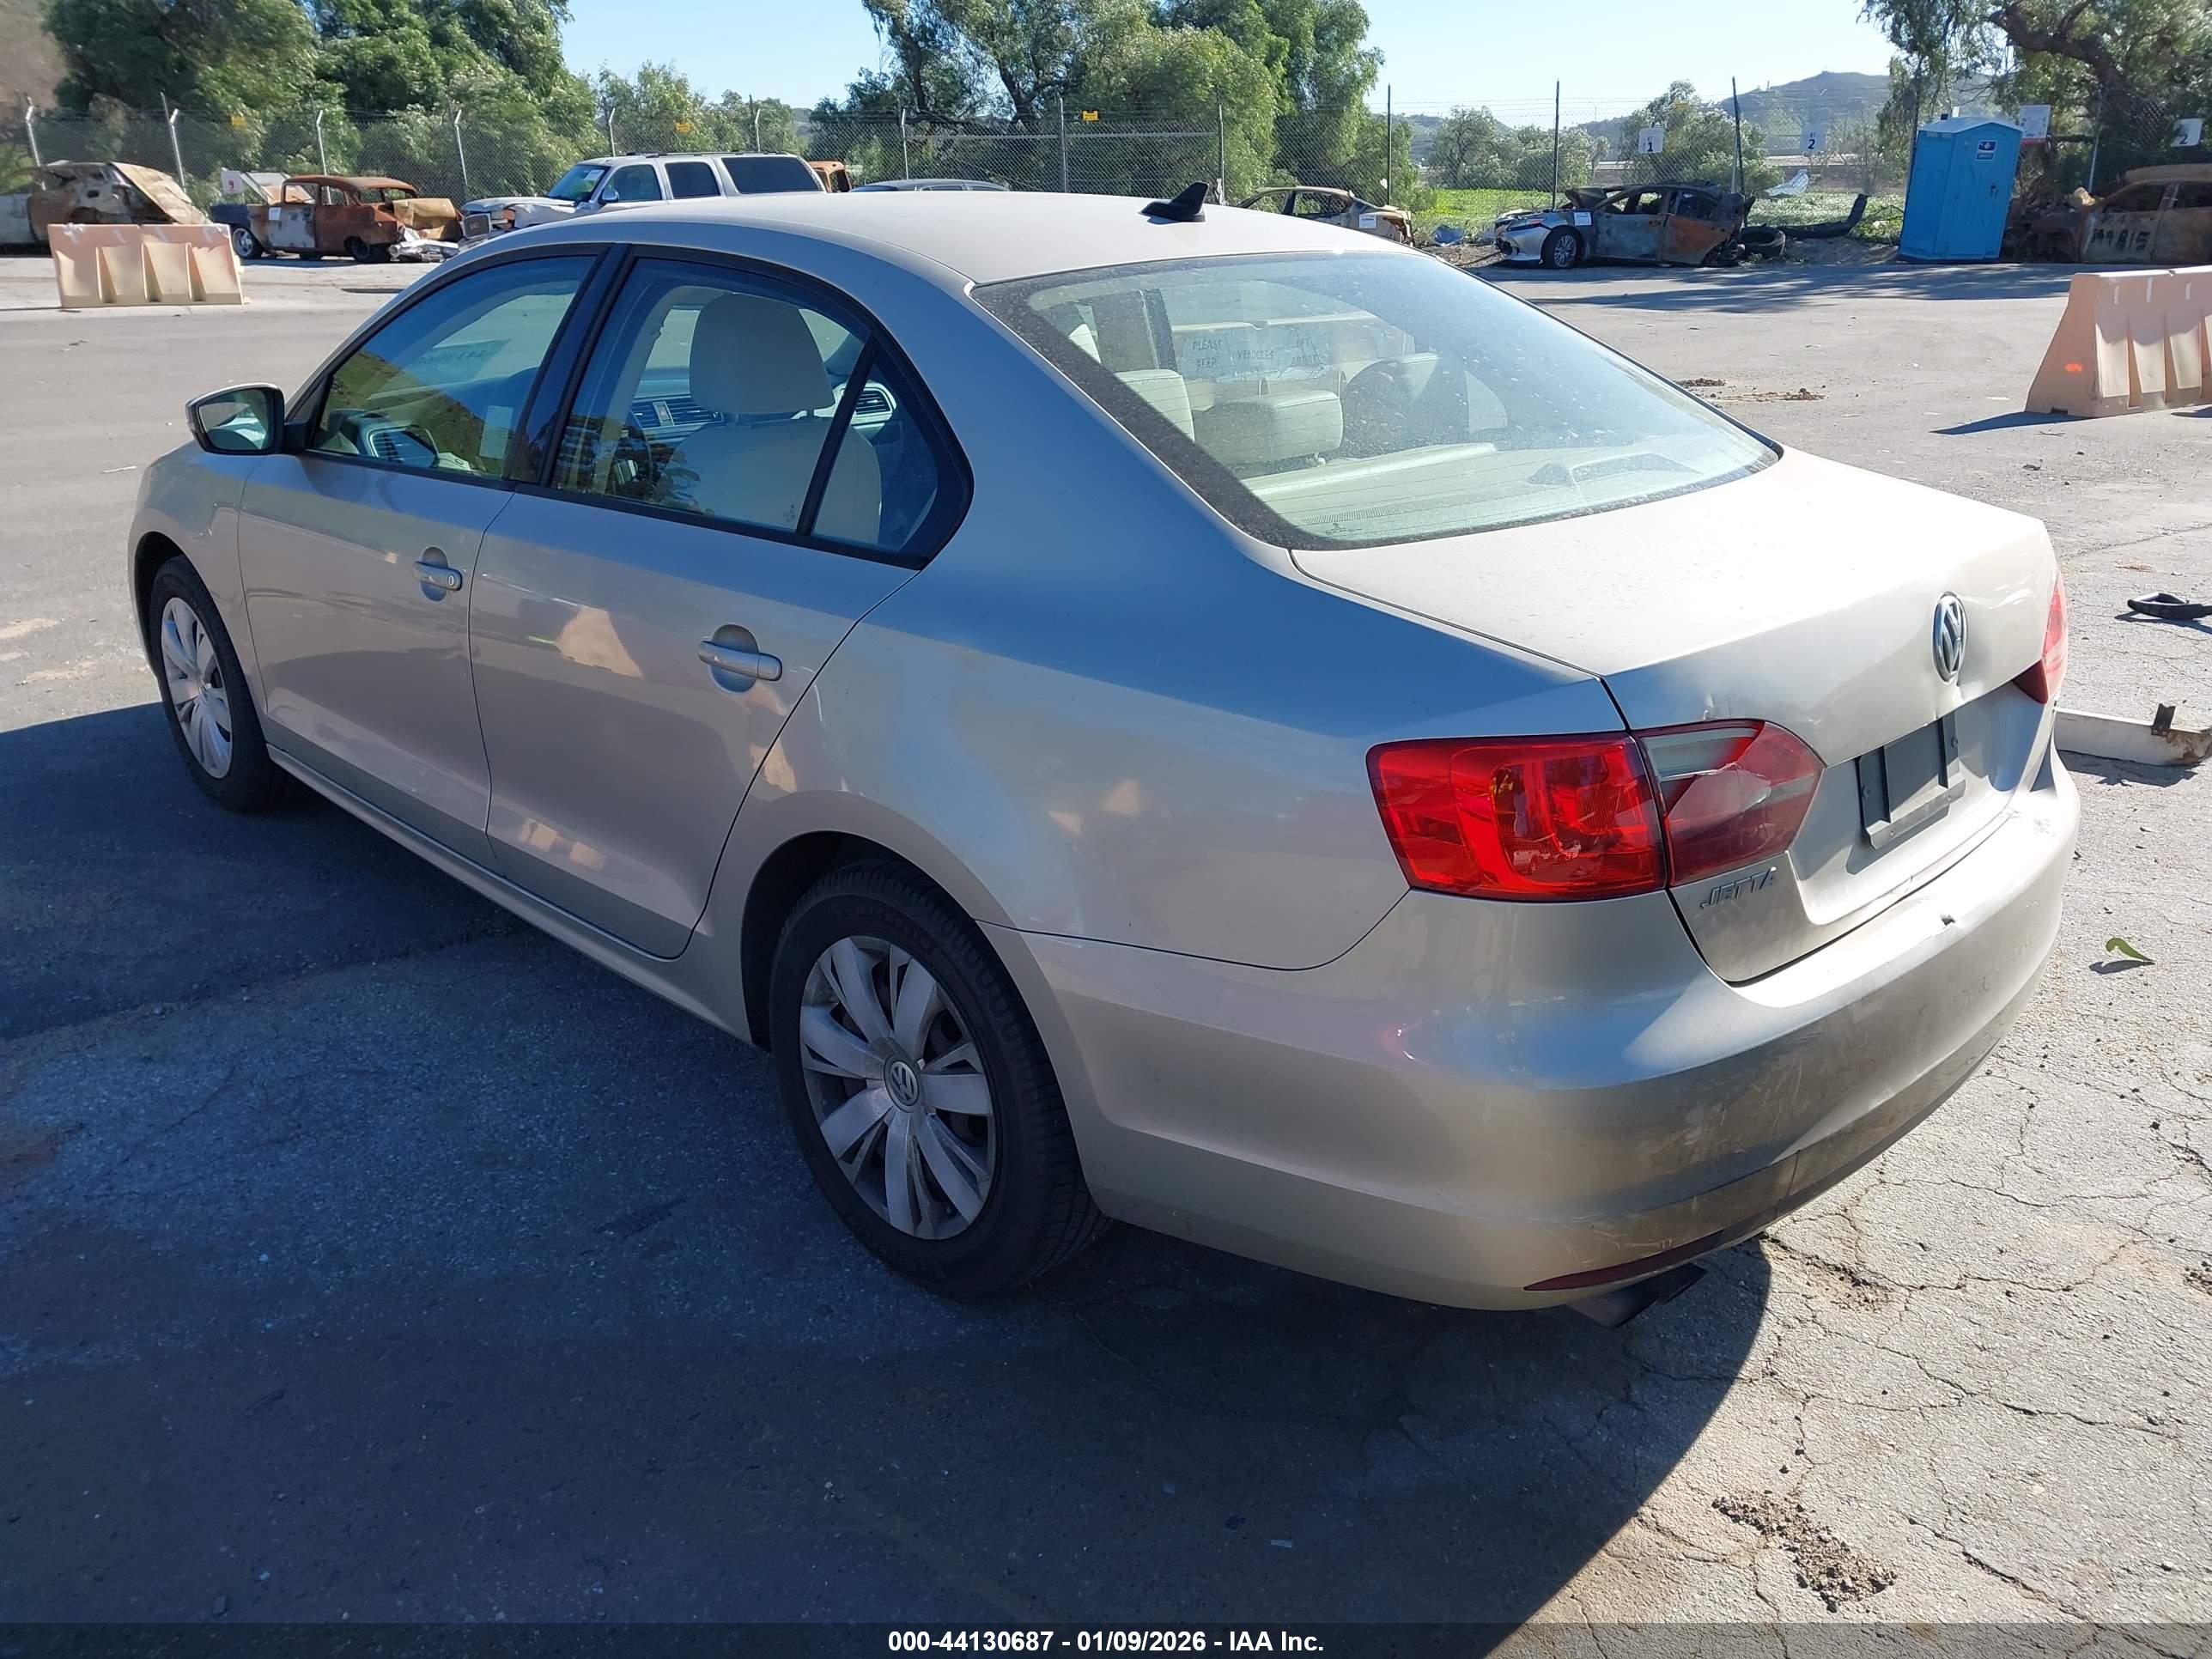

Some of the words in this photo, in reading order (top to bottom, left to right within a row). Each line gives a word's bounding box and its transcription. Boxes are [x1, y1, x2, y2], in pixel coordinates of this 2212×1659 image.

[1646, 142, 1653, 152] 1
[1808, 138, 1815, 149] 2
[1699, 866, 1777, 909] JETTA
